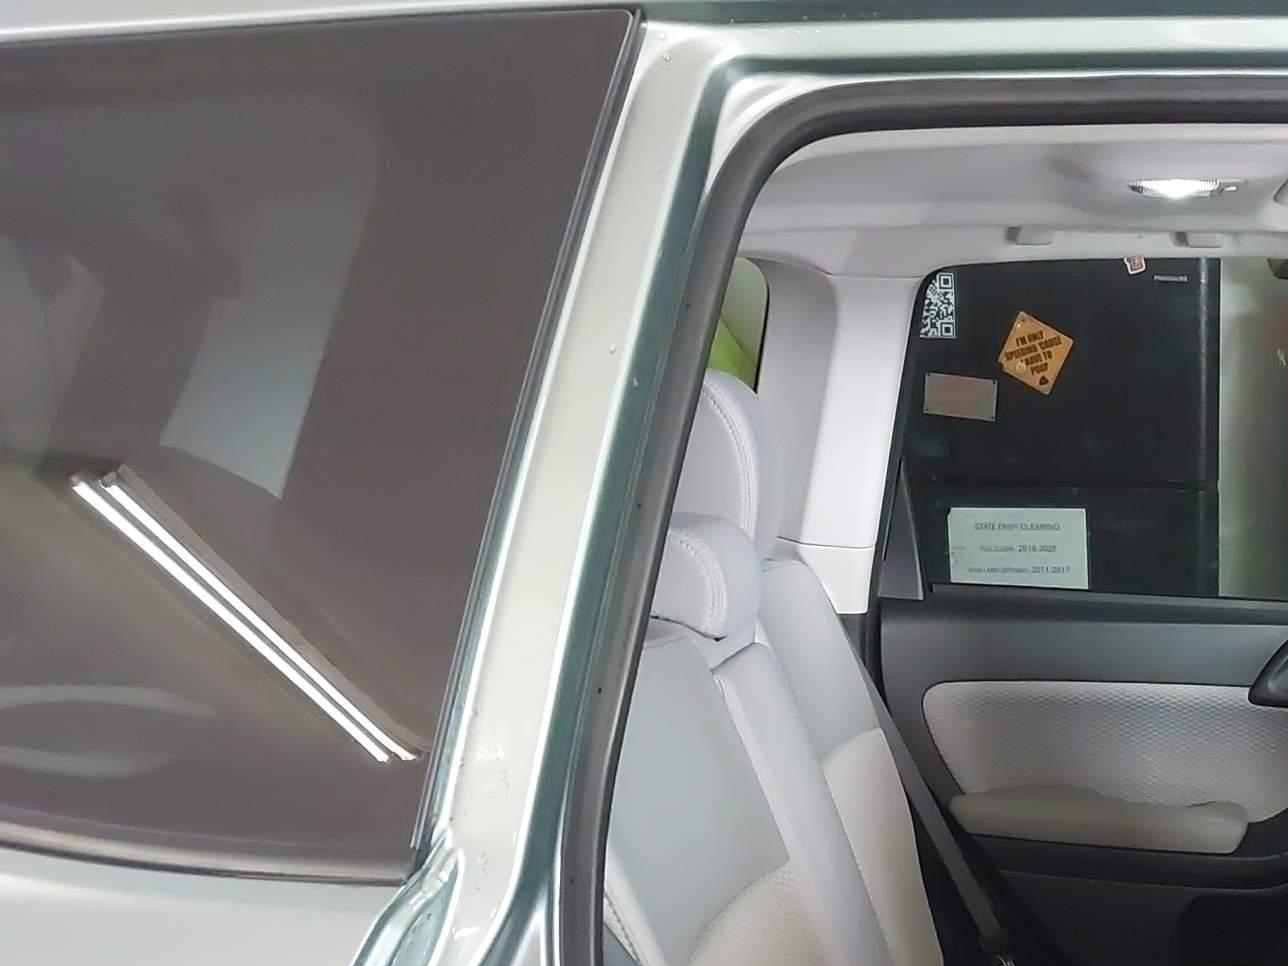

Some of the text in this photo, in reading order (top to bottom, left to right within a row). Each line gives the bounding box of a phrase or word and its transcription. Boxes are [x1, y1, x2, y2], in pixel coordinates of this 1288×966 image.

[1015, 330, 1044, 347] I'M ONLY
[1005, 344, 1038, 361] SPEEDING
[1025, 353, 1042, 367] HAVE
[1042, 350, 1053, 361] TO
[1030, 362, 1048, 376] POOP
